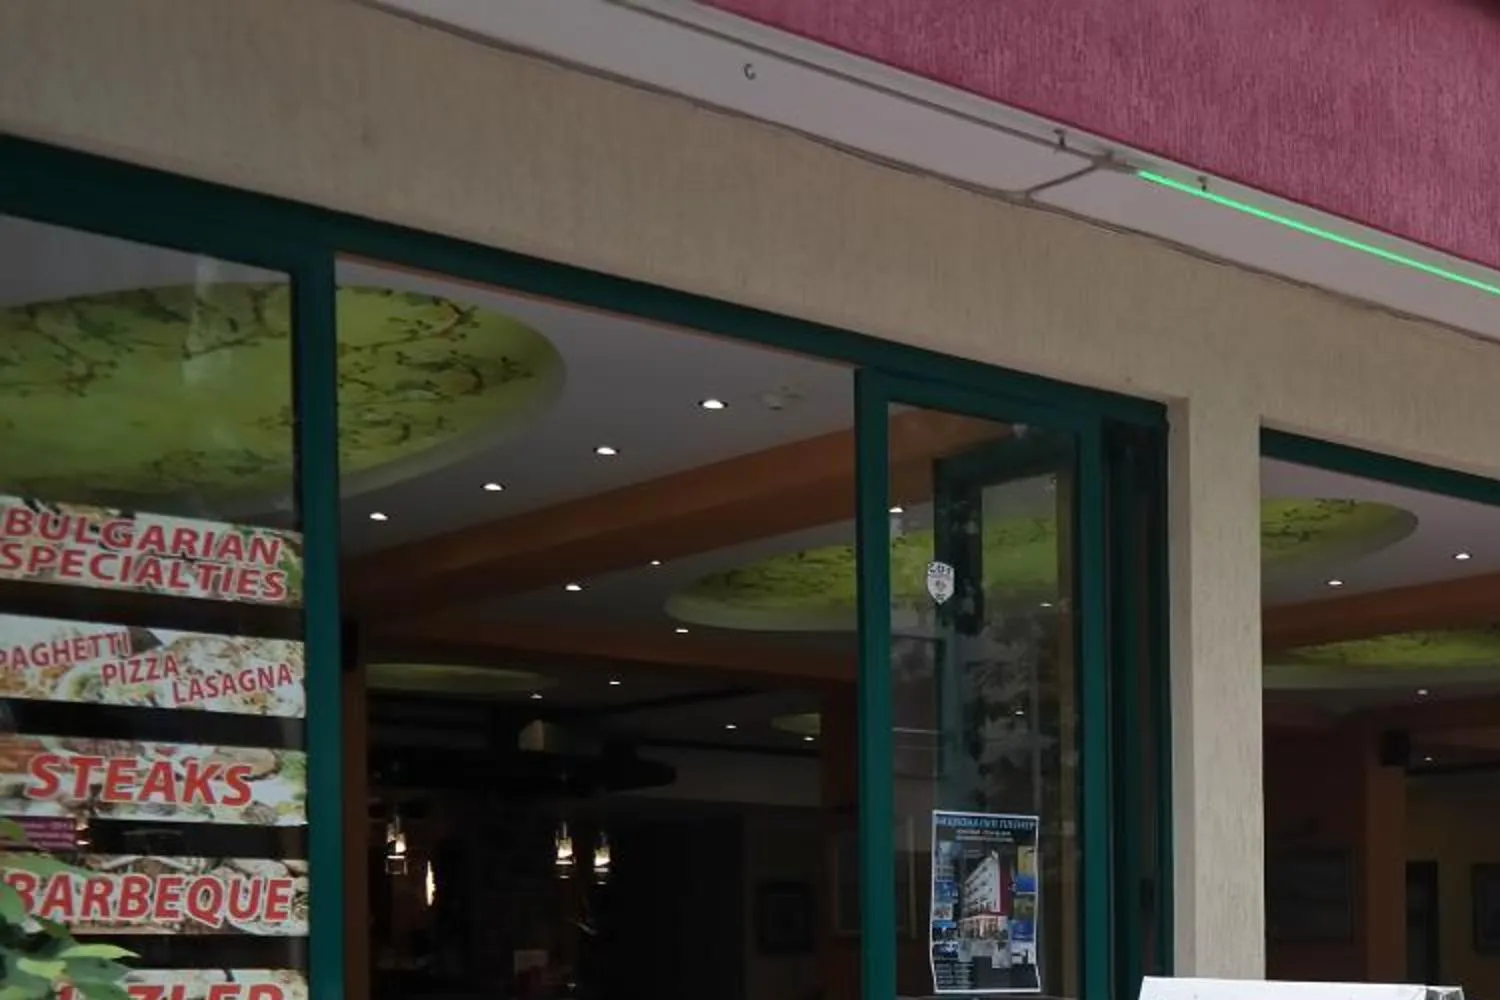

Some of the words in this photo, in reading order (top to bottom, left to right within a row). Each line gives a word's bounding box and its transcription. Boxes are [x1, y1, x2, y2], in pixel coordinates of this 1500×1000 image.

[4, 508, 281, 566] BULGARIAN
[0, 544, 286, 599] SPECIALTIES
[102, 655, 180, 687] PIZZA
[172, 663, 293, 703] LASAGNA
[27, 755, 253, 807] STEAKS
[6, 873, 292, 927] BARBEQUE
